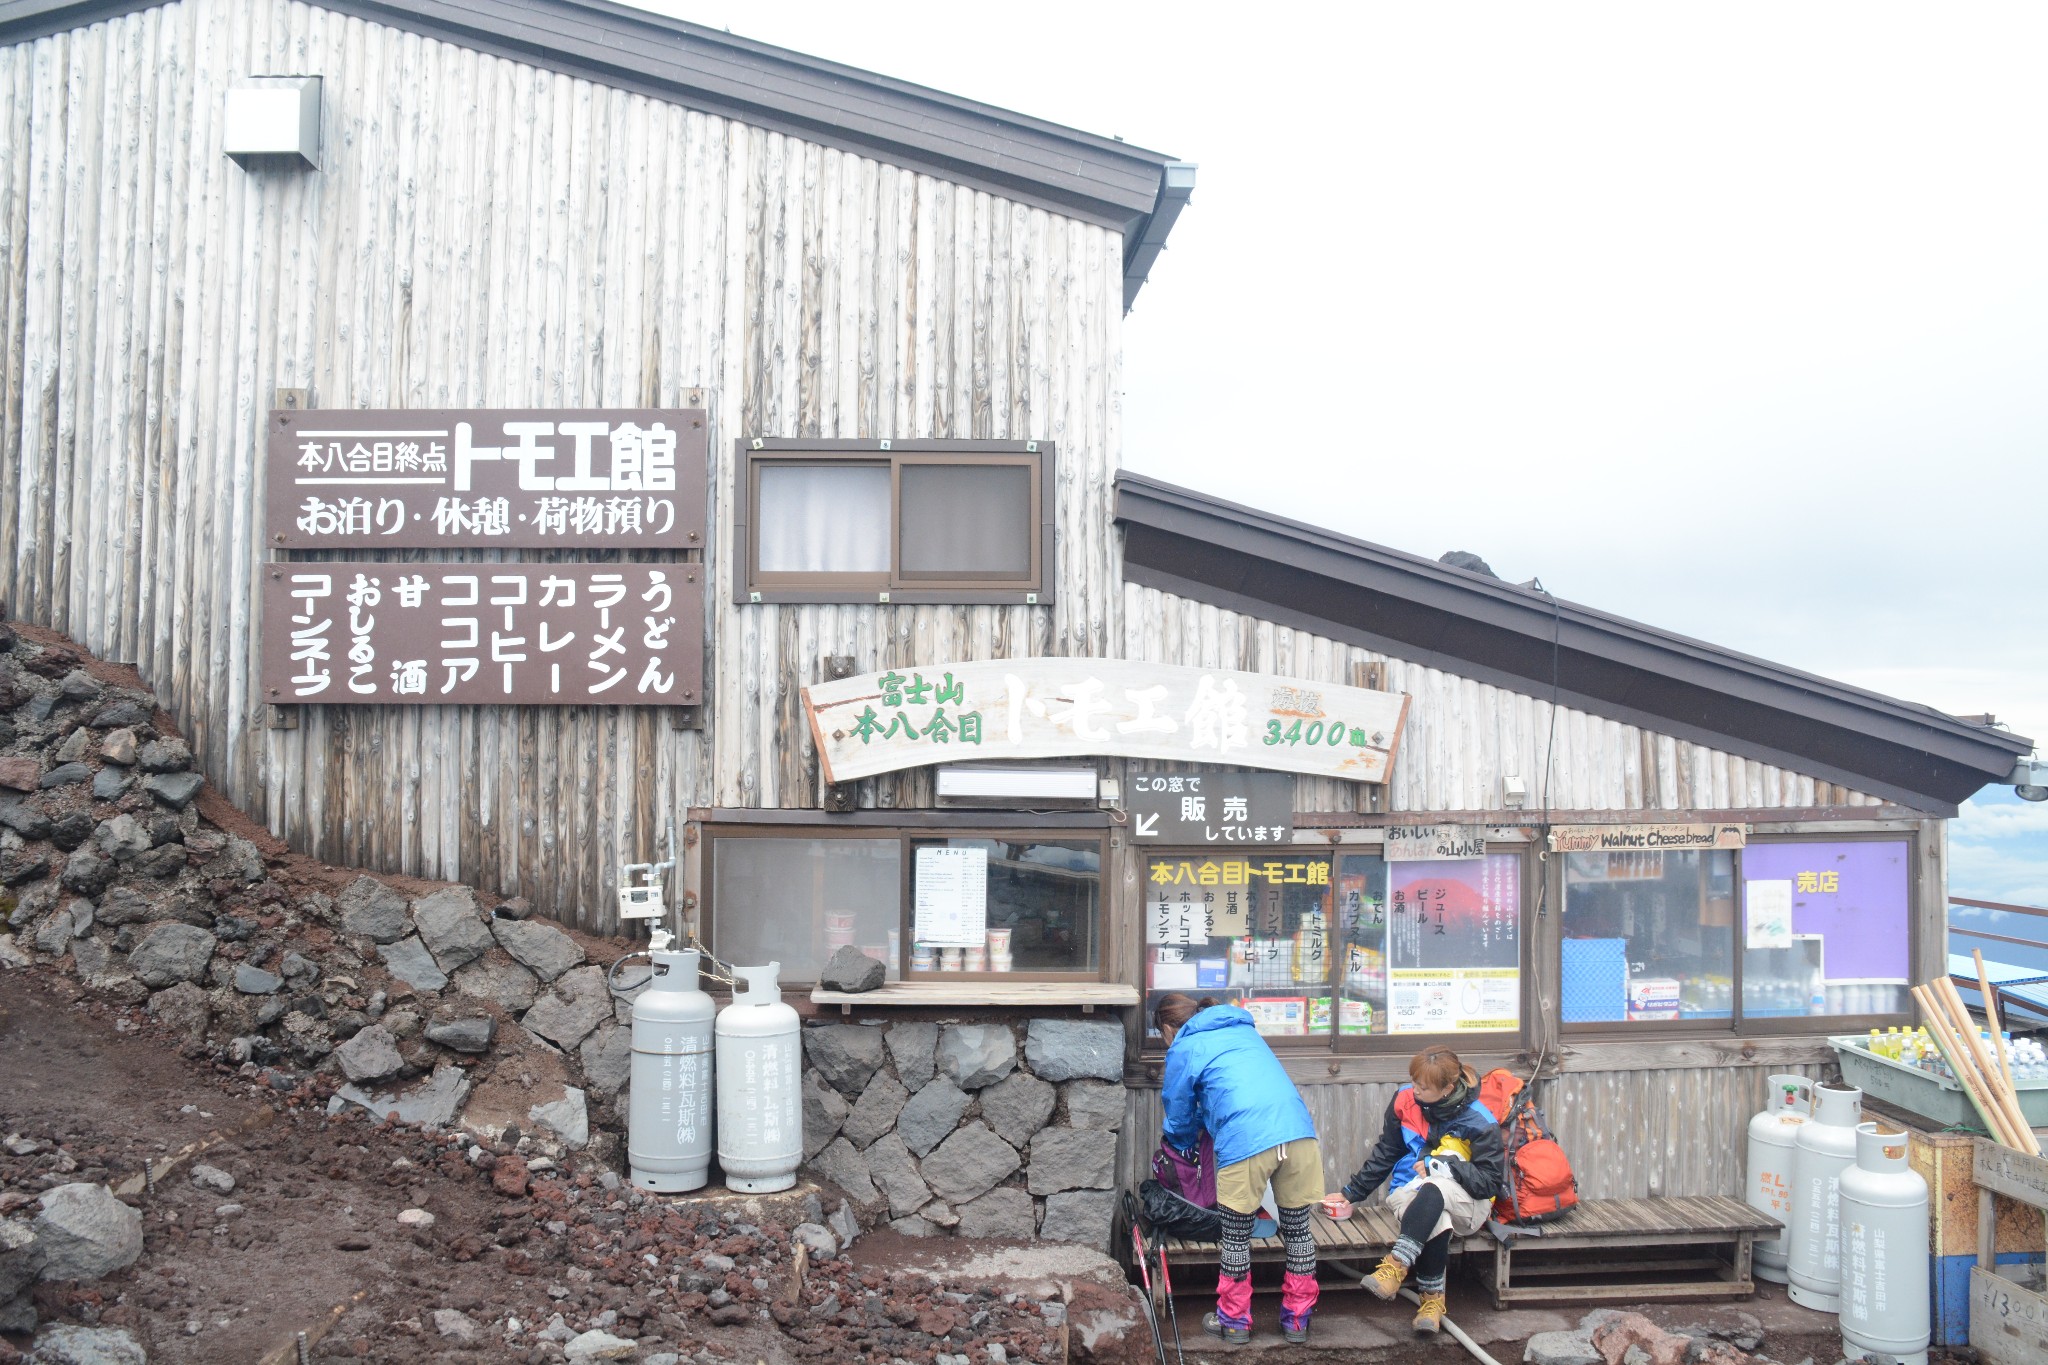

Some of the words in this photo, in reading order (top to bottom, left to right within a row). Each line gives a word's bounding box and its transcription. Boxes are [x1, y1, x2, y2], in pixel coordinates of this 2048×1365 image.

[297, 441, 447, 472] 本八合目終点
[454, 421, 676, 491] トモエ館
[290, 574, 332, 696] コーンスープ
[346, 574, 381, 694] おしるこ
[390, 574, 430, 695] 甘酒
[440, 575, 479, 695] ココア
[490, 575, 527, 694] コーヒー
[539, 574, 576, 693] カレー
[588, 573, 627, 695] ラーメン
[637, 570, 675, 694] うどん
[878, 671, 964, 708] 富士山
[849, 704, 983, 745] 本八合目
[1004, 672, 1248, 755] トモエ館
[1135, 776, 1200, 793] この窓で
[1180, 796, 1248, 821] 販売
[1206, 825, 1285, 841] しています
[1388, 825, 1435, 840] おいしい
[1553, 831, 1599, 851] Yummy
[1601, 831, 1644, 847] Walnut
[1150, 861, 1329, 885] 本八合目トモエ館
[1797, 870, 1839, 893] 売店
[1204, 891, 1214, 937] おしるこ
[1226, 891, 1238, 914] 甘酒
[1372, 890, 1383, 924] おでん
[1393, 890, 1405, 913] お酒
[1417, 889, 1428, 923] ビール
[1434, 888, 1446, 935] ジュース
[1158, 891, 1169, 961] レモンティー
[1180, 891, 1190, 961] ホットココア
[1245, 891, 1256, 972] ホットコーヒー
[1268, 891, 1279, 960] コーンスープ
